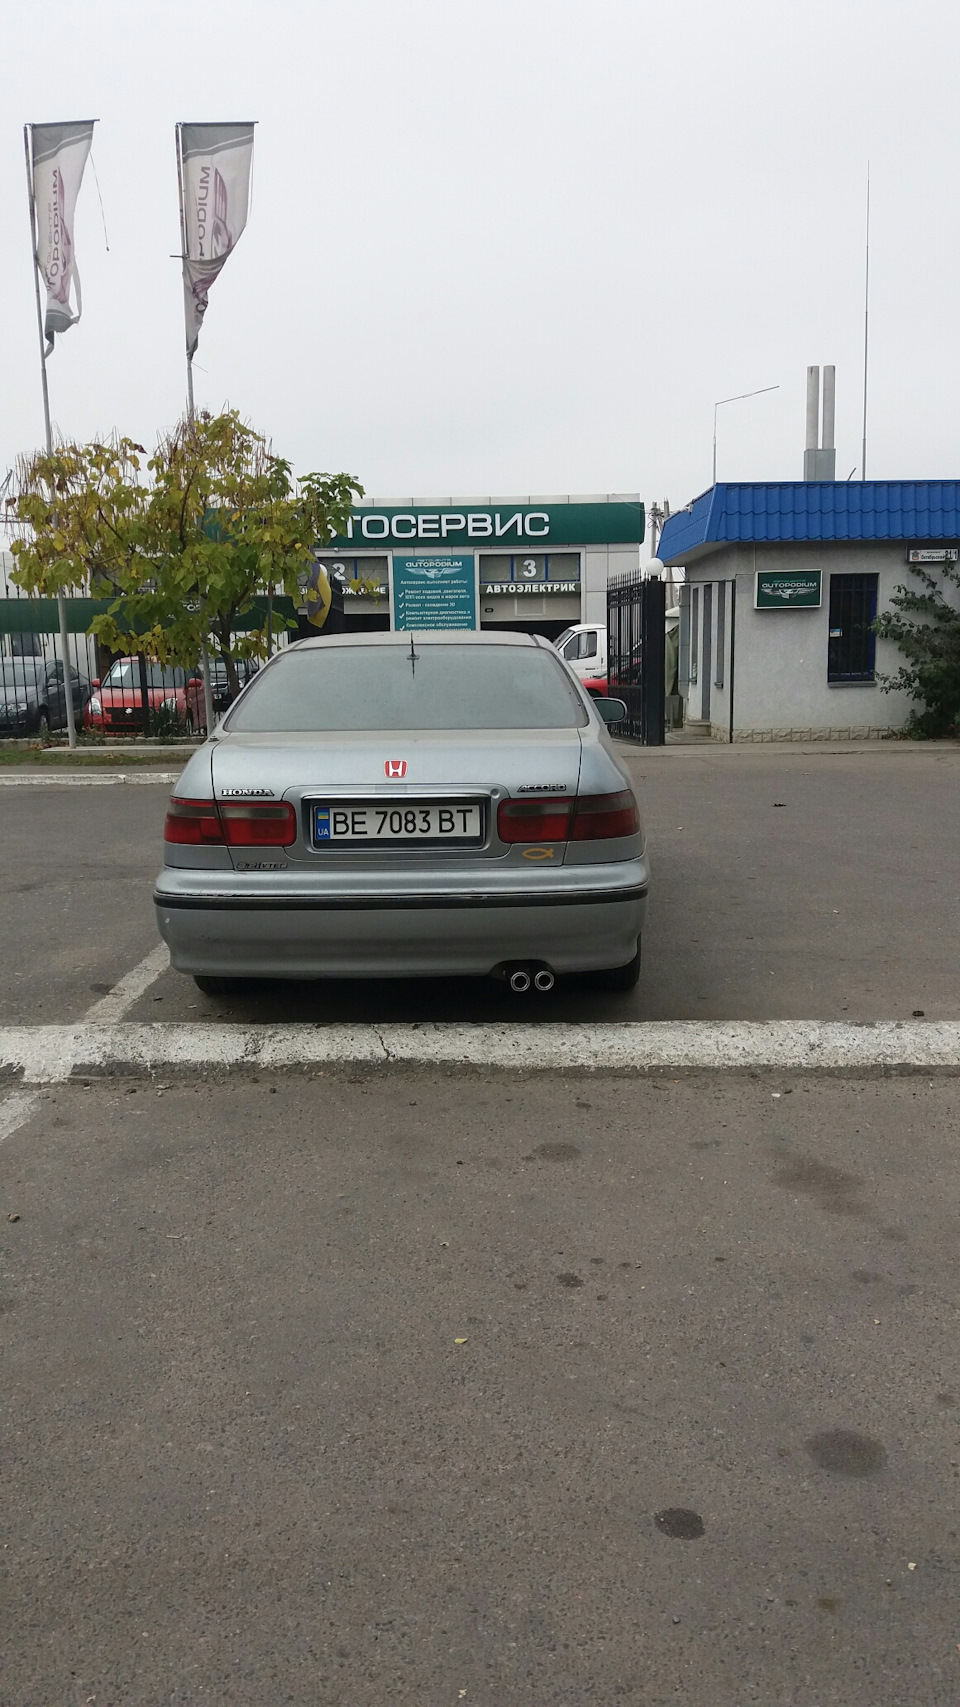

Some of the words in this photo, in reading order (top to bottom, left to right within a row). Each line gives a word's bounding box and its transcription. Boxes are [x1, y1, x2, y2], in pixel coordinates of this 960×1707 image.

[311, 512, 550, 539] ТОСЕРВИС
[332, 563, 346, 580] 2
[523, 559, 537, 578] 3
[486, 583, 576, 593] АВТОЭЛЕКТРИК
[222, 789, 274, 797] HONDA
[517, 784, 567, 792] ACCORD
[318, 828, 330, 836] UA
[333, 810, 368, 836] BE
[375, 809, 431, 835] 7083
[438, 809, 473, 834] BT
